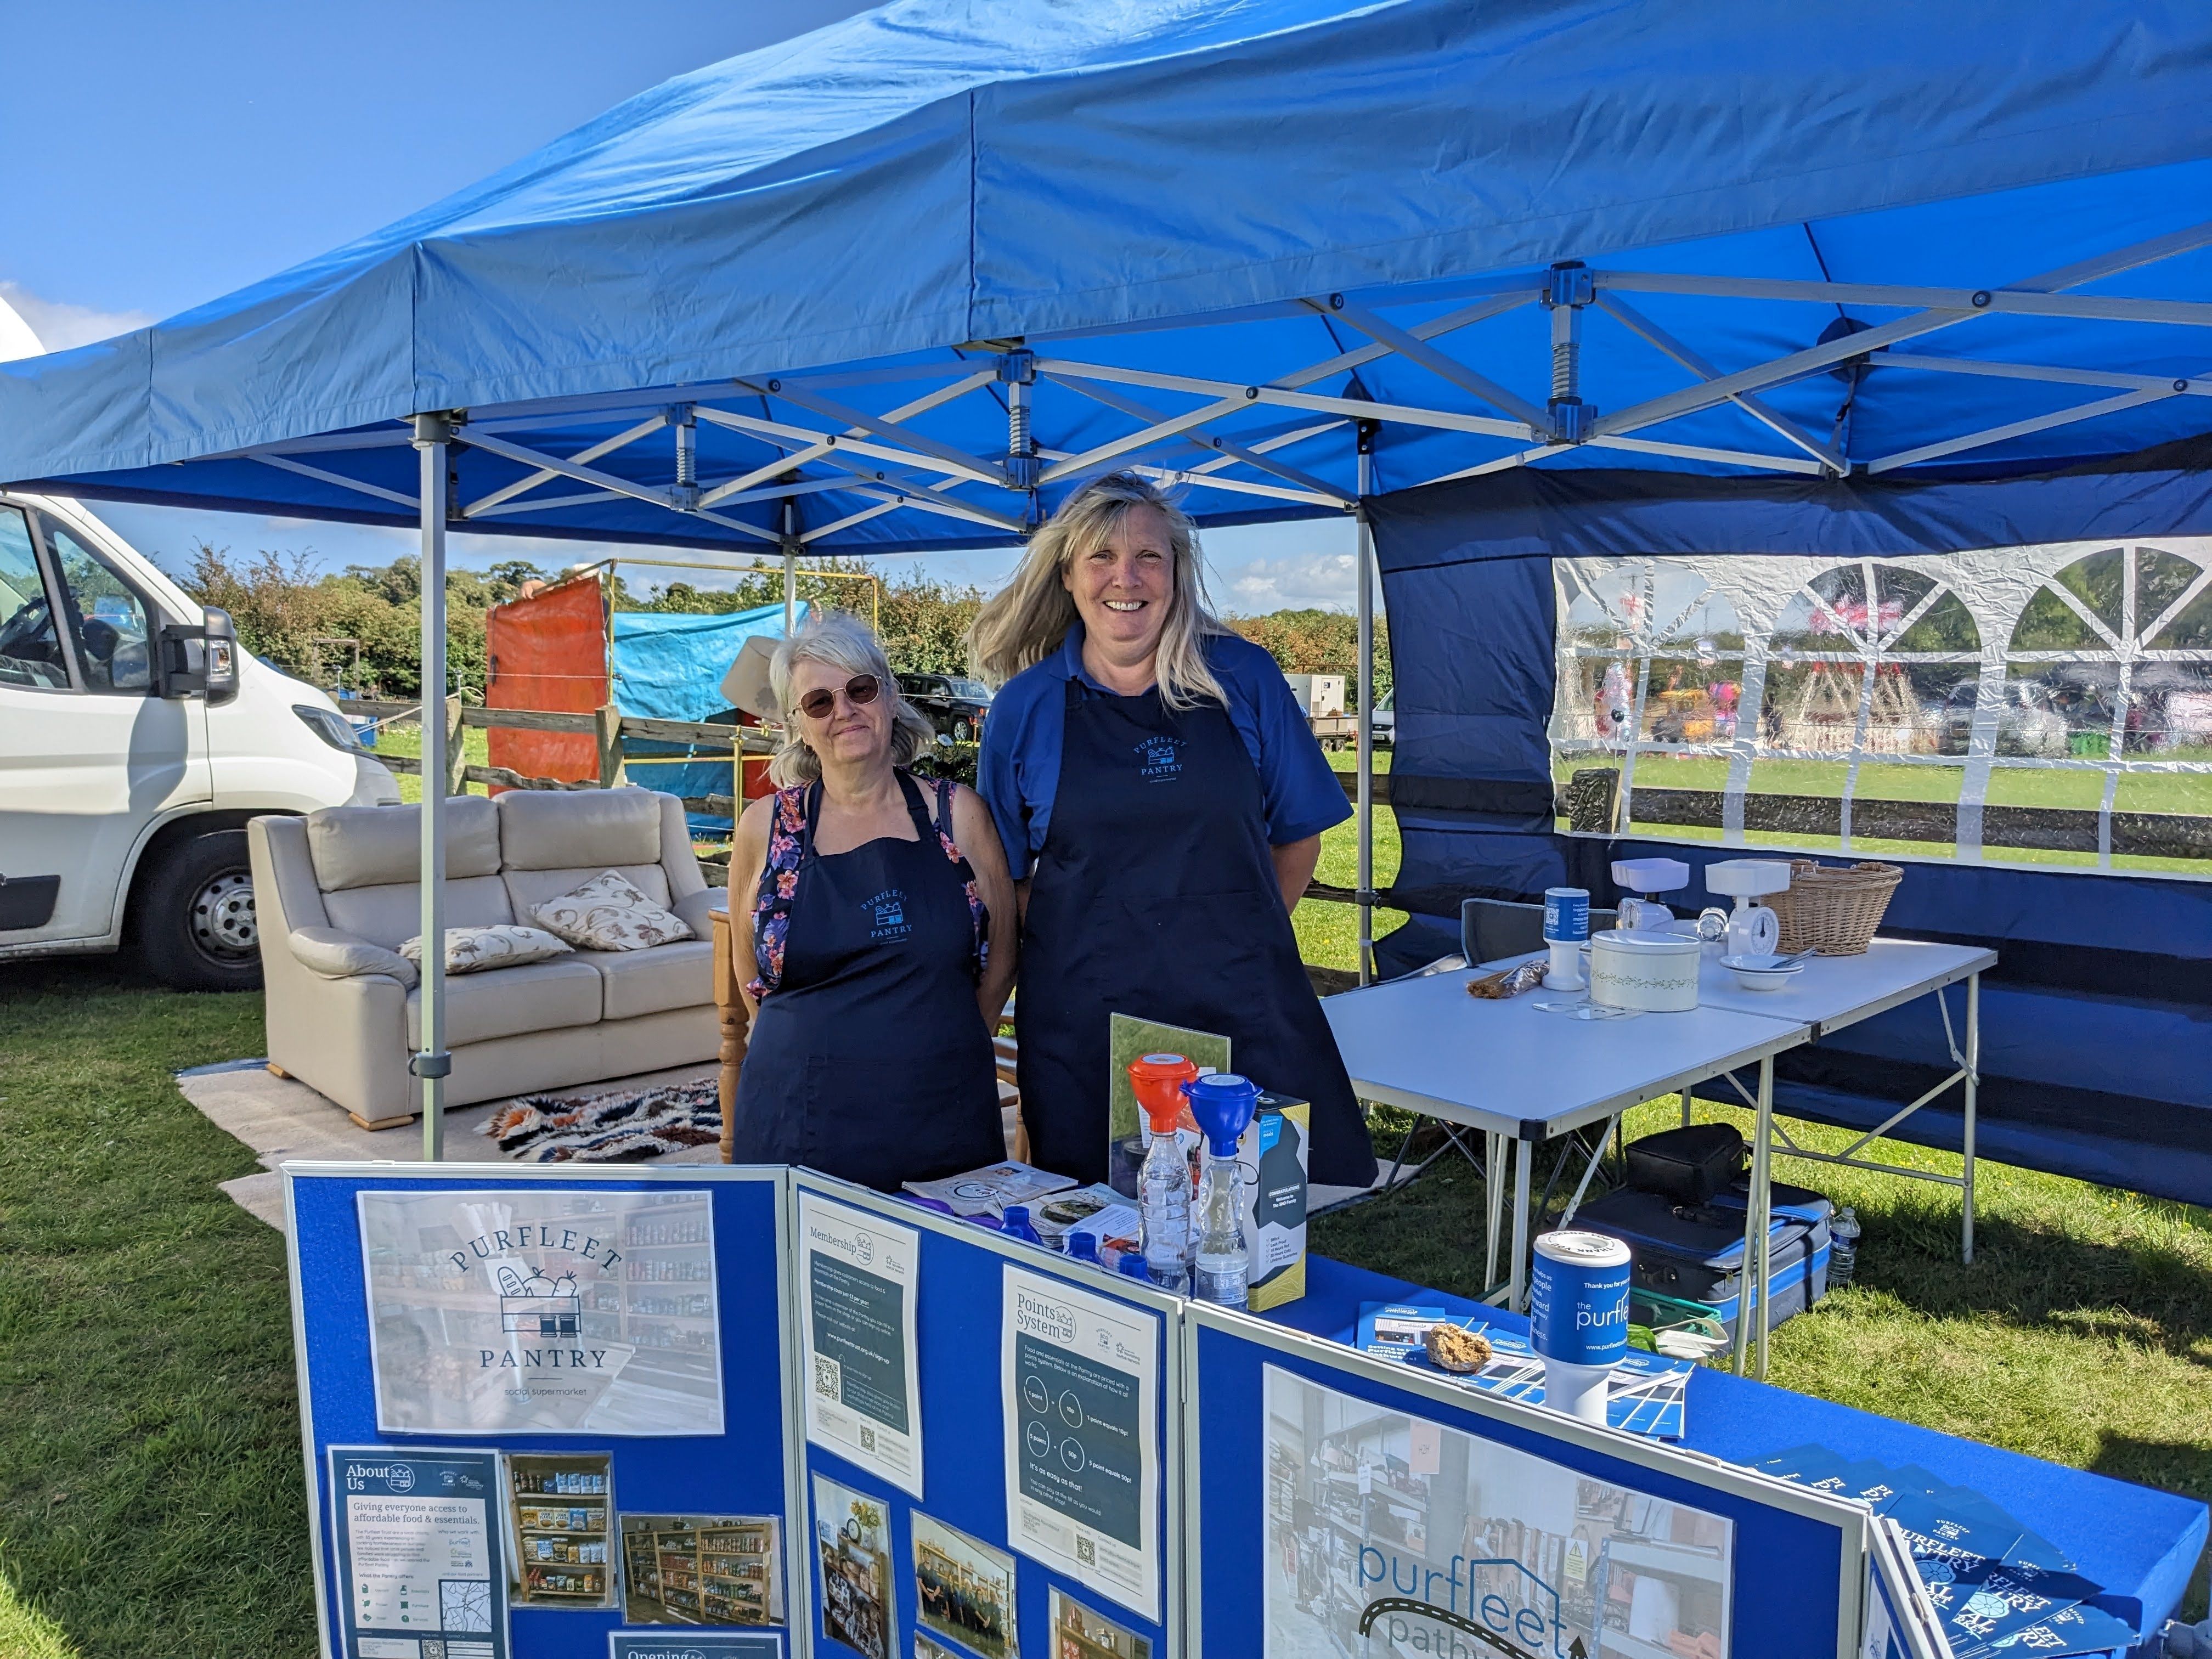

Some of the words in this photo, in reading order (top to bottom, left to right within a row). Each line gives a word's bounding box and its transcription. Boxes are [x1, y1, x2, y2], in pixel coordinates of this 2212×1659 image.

[1133, 737, 1188, 753] PURFLEET
[1141, 764, 1182, 775] PANTRY
[860, 889, 909, 910] PURFLEET
[871, 925, 912, 938] PANTRY
[1269, 1185, 1300, 1197] CONGRATULATIONS
[810, 1226, 856, 1255] Membership
[1550, 1243, 1571, 1251] YOU
[449, 1226, 622, 1273] PURFLEET
[842, 1272, 858, 1283] customers
[1534, 1276, 1551, 1291] people
[814, 1278, 833, 1292] Membership
[860, 1298, 869, 1307] year!
[1017, 1293, 1056, 1319] Points
[1577, 1302, 1591, 1310] the
[1017, 1309, 1060, 1339] System
[479, 1350, 607, 1368] PANTRY
[1024, 1352, 1037, 1362] points
[1054, 1363, 1066, 1373] Below
[1077, 1373, 1102, 1389] explanation
[1108, 1385, 1117, 1393] how
[1025, 1344, 1035, 1354] Food
[1035, 1348, 1043, 1357] and
[1045, 1352, 1064, 1365] essentials
[1078, 1365, 1092, 1378] Pantry
[1101, 1374, 1114, 1386] priced
[1116, 1380, 1124, 1389] with
[505, 1387, 529, 1396] social
[532, 1387, 586, 1396] supermarket
[1031, 1392, 1043, 1401] point
[1090, 1416, 1102, 1425] point
[1103, 1421, 1118, 1433] equals
[1119, 1427, 1128, 1436] 10p!
[1033, 1436, 1046, 1445] points
[1068, 1451, 1077, 1459] 50p
[346, 1465, 390, 1478] About
[1093, 1462, 1104, 1471] point
[1105, 1466, 1121, 1478] equals
[1121, 1473, 1132, 1483] 50p!
[347, 1477, 365, 1490] Us
[1039, 1467, 1045, 1475] as
[1047, 1470, 1059, 1483] easy
[1060, 1477, 1068, 1486] as
[1069, 1480, 1082, 1493] that!
[353, 1502, 382, 1513] Giving
[385, 1504, 426, 1514] everyone
[459, 1504, 467, 1513] to
[1088, 1505, 1101, 1516] would
[354, 1513, 400, 1523] affordable
[403, 1514, 422, 1523] food
[425, 1515, 432, 1523] &
[435, 1515, 479, 1525] essentials.
[1936, 1519, 1970, 1533] PURFLEET
[1932, 1529, 1959, 1541] PANTRY
[1358, 1543, 1567, 1659] purfleet
[628, 1651, 689, 1659] Opening
